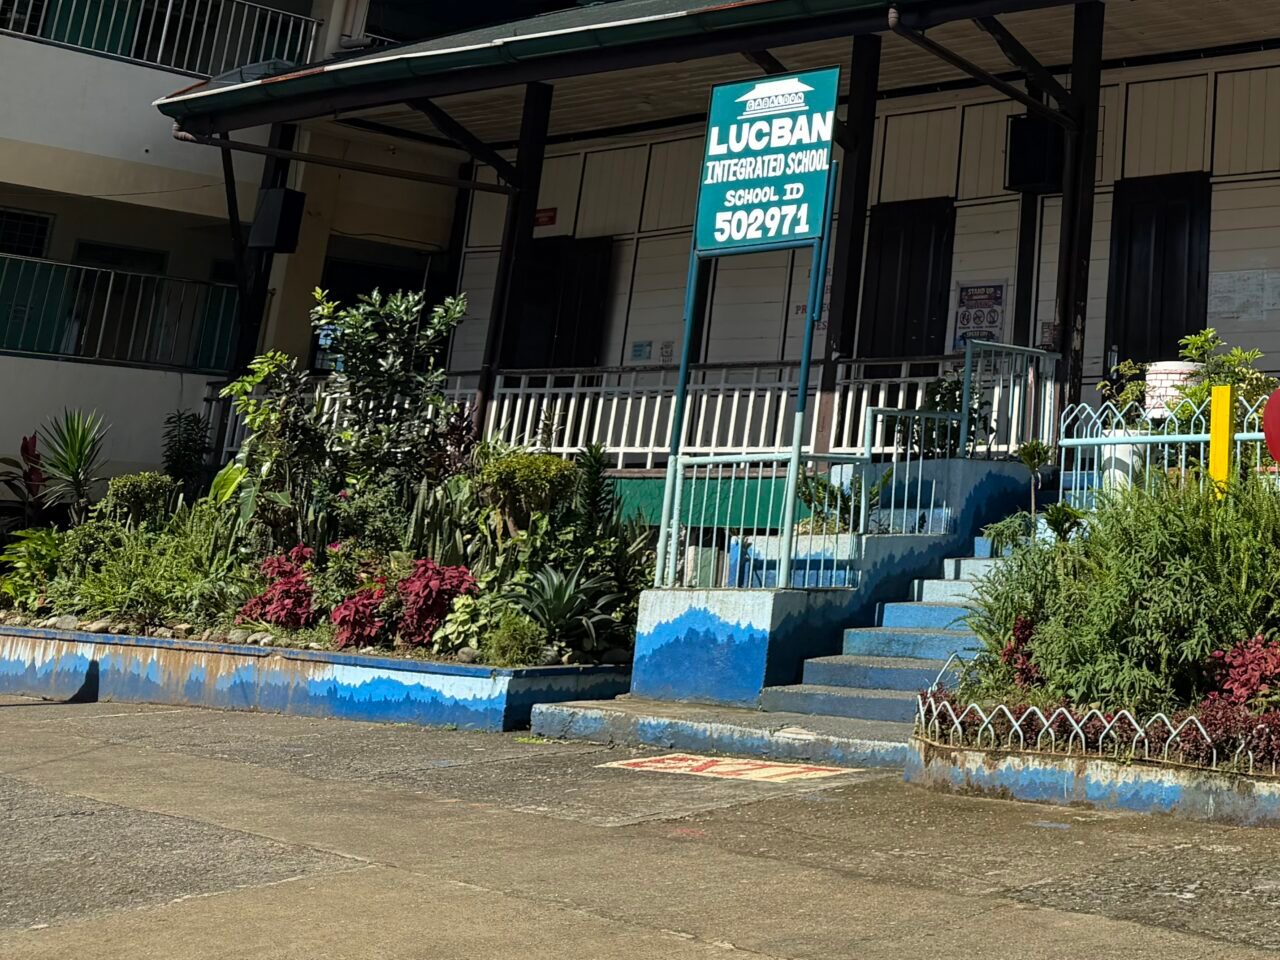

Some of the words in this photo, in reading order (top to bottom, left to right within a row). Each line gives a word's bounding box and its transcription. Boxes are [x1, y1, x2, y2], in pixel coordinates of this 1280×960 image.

[747, 93, 804, 110] GABALDON
[708, 111, 834, 155] LUCBAN
[704, 153, 785, 184] INTEGRATED
[785, 148, 829, 175] SCHOOL
[724, 186, 779, 207] SCHOOL
[783, 182, 804, 200] ID
[714, 203, 809, 242] 502971
[1209, 384, 1234, 499] I
